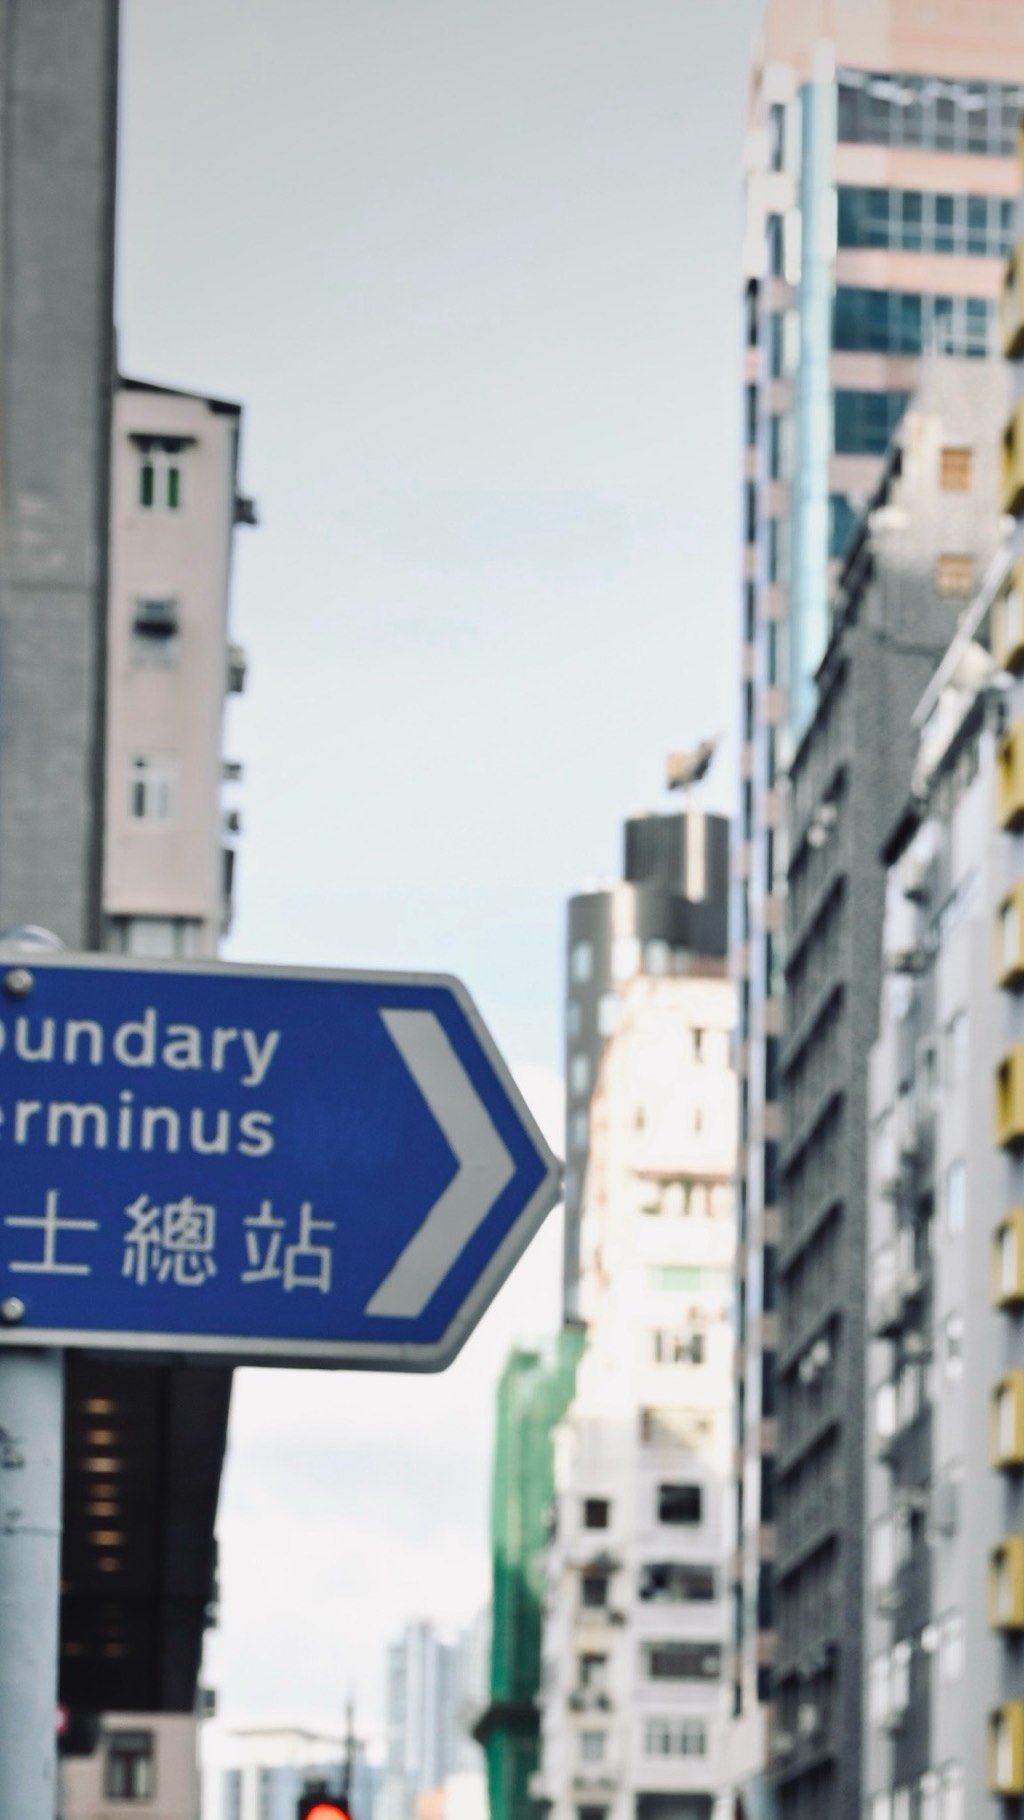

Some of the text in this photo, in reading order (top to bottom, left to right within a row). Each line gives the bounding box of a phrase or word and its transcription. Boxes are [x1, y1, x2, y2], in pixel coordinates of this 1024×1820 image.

[0, 1006, 280, 1087] undary
[0, 1088, 274, 1157] rminus
[4, 1188, 336, 1294] 士總站
